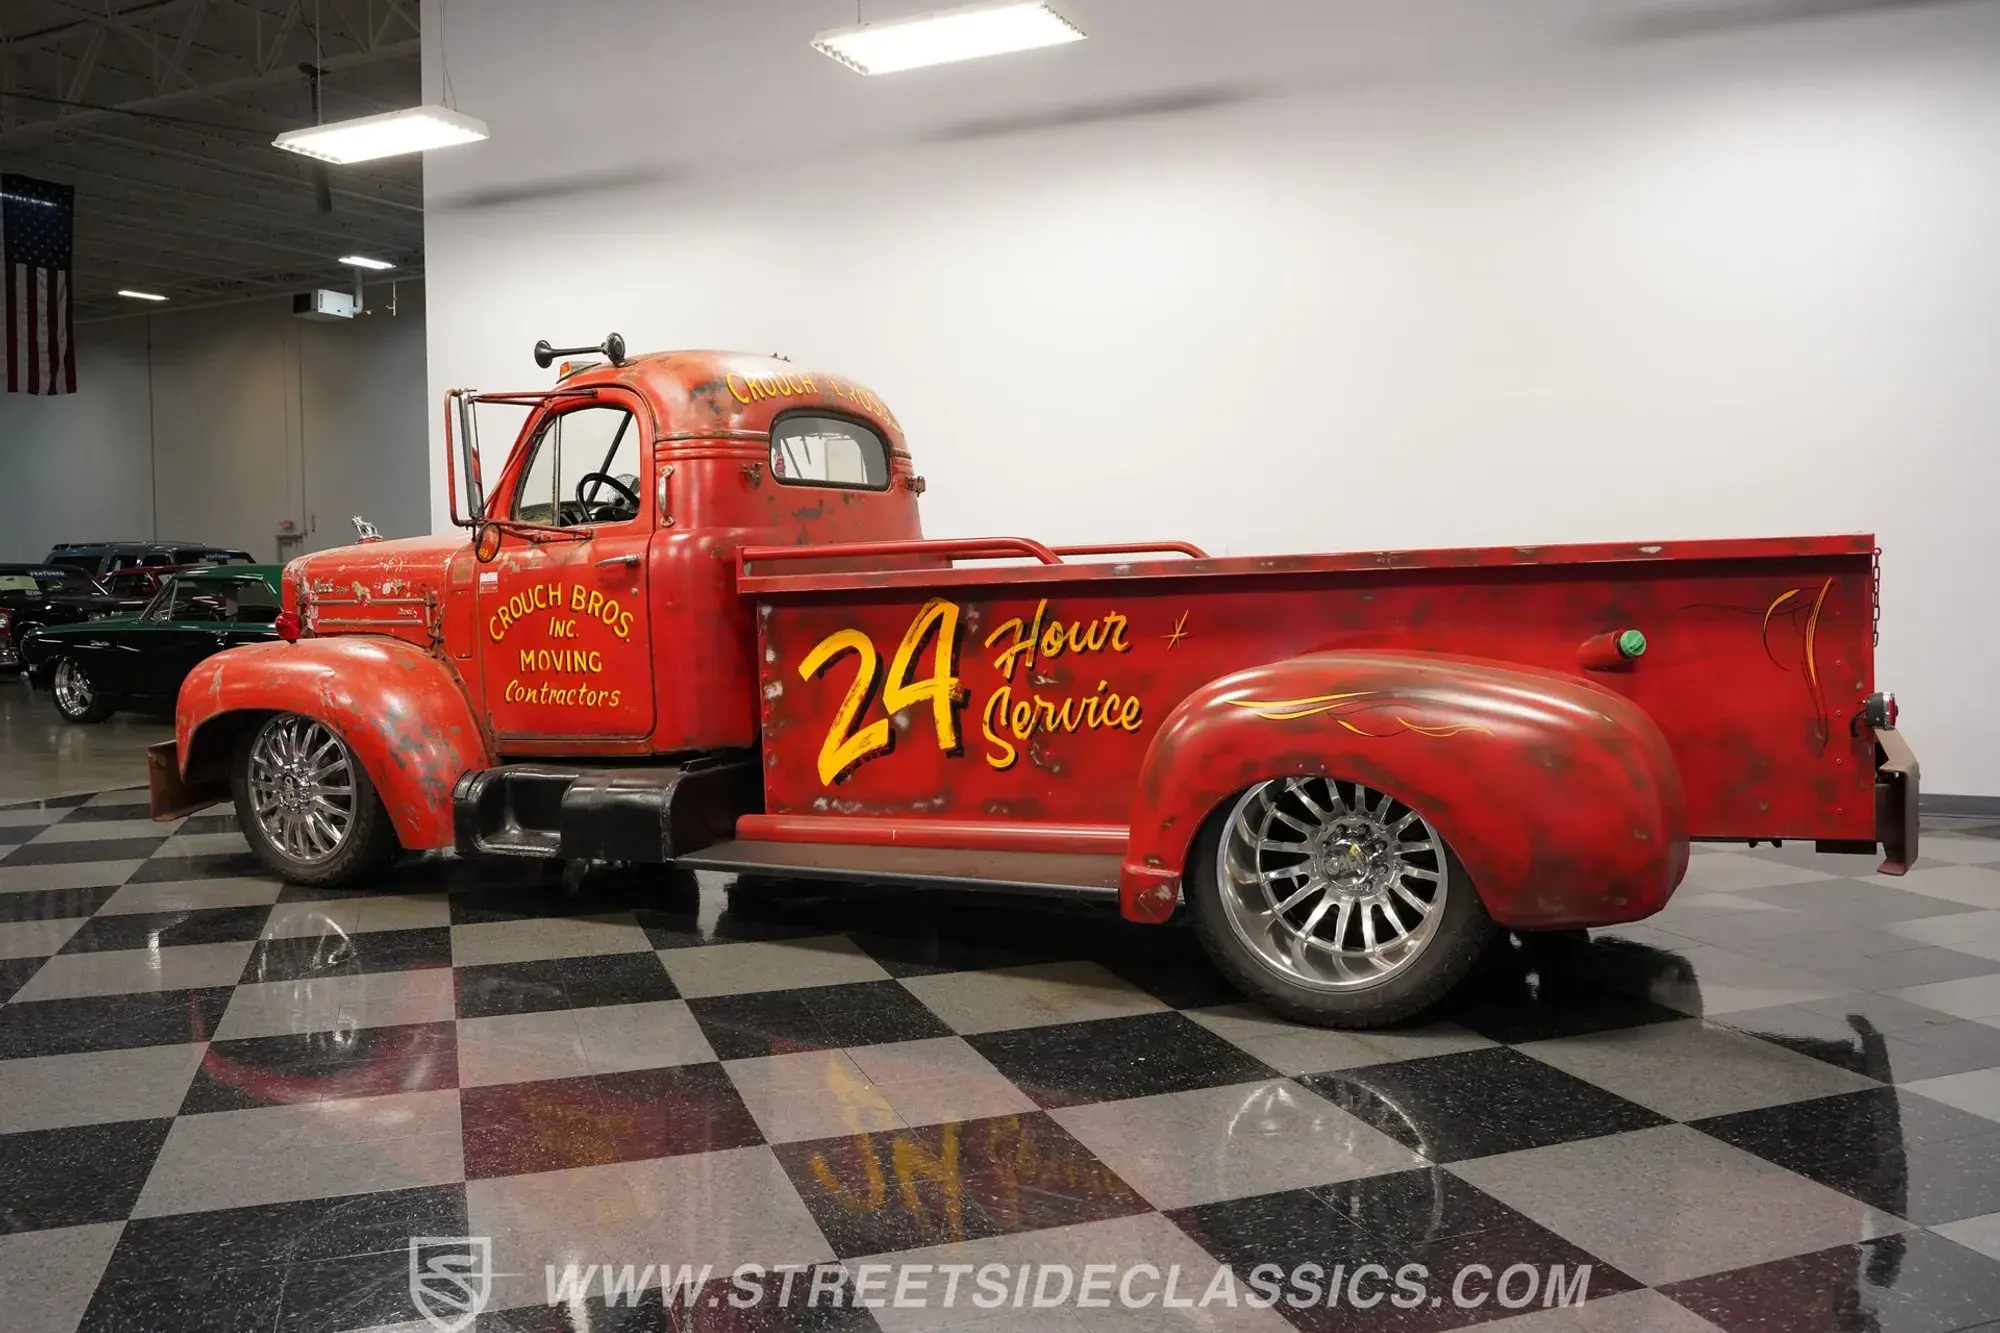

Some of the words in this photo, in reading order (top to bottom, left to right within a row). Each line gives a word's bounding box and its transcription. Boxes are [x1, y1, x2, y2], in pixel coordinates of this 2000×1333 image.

[725, 371, 818, 404] CROUCH
[489, 583, 562, 641] CROUCH
[571, 584, 634, 643] BROS.
[548, 616, 580, 638] INC.
[520, 649, 602, 673] MOVING
[505, 679, 621, 707] Contractors
[798, 597, 963, 786] 24
[984, 598, 1130, 679] Hour
[982, 679, 1143, 768] Service
